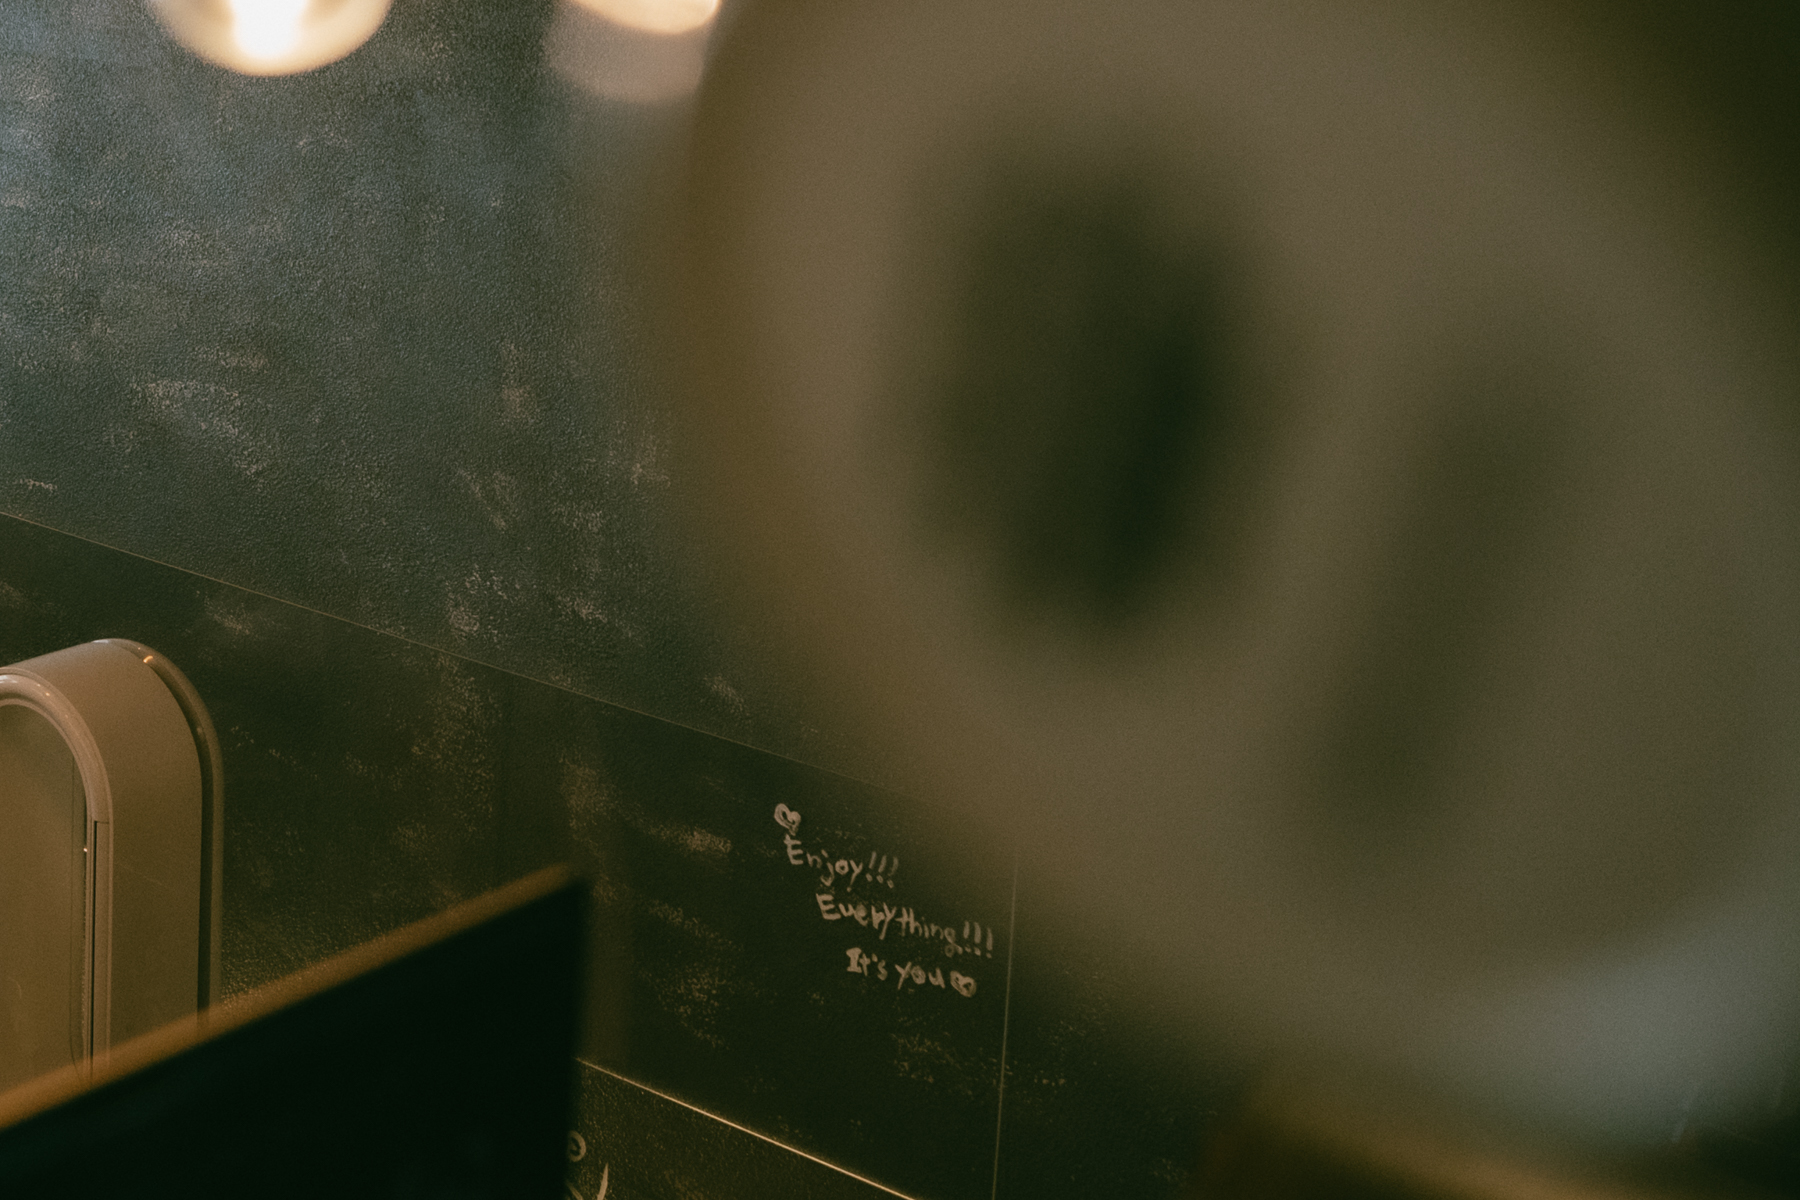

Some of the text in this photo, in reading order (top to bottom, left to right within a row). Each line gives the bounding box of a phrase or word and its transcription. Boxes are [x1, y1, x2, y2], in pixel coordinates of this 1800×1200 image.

[784, 833, 898, 891] Enjoy!!!
[816, 893, 993, 959] Everything!!!
[846, 947, 888, 981] It's
